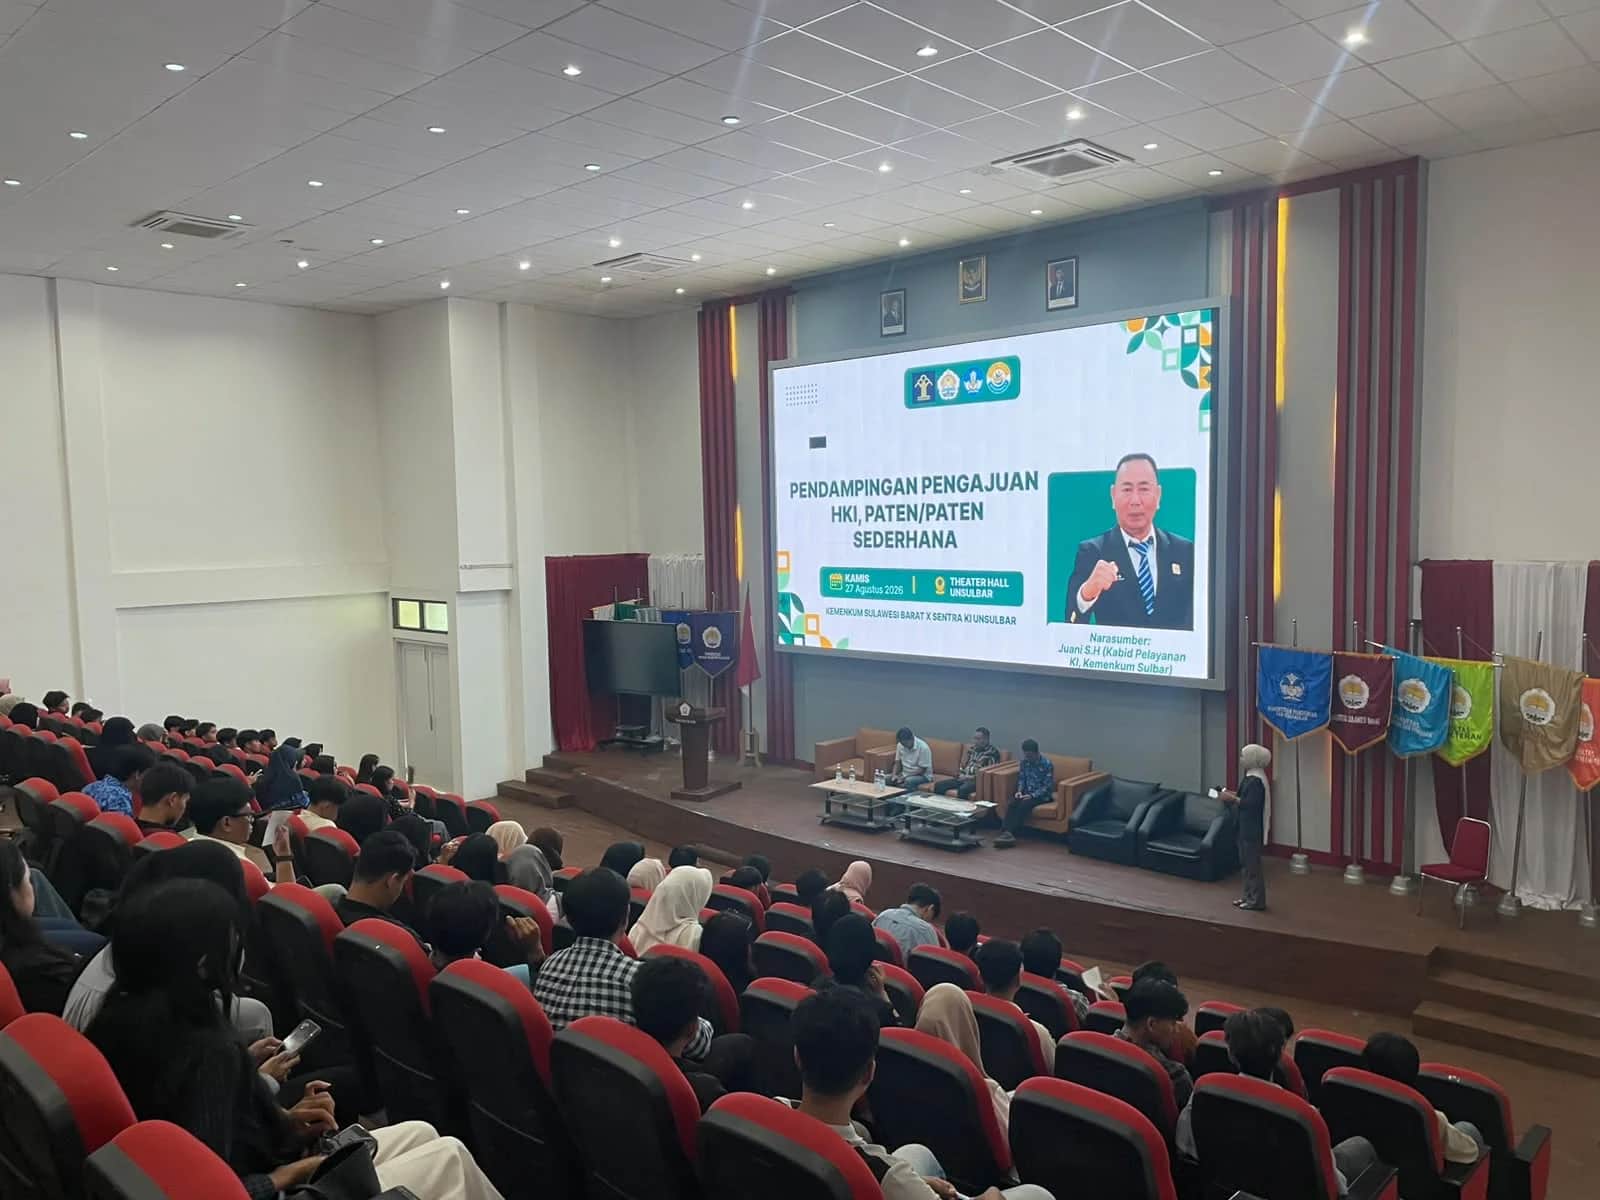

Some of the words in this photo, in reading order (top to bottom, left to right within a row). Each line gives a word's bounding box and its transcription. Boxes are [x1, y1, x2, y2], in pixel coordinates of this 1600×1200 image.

[790, 477, 918, 499] PENDAMPINGAN
[922, 471, 1039, 494] PENGAJUAN
[831, 505, 862, 526] HKI,
[865, 502, 984, 523] PATEN/PATEN
[853, 530, 958, 549] SEDERHANA
[845, 573, 870, 583] KAMIS
[950, 577, 988, 587] THEATER
[988, 578, 1010, 588] HALL
[845, 584, 854, 593] 27
[855, 585, 883, 595] Agustus
[950, 588, 993, 598] UNSULBAR
[825, 608, 863, 617] KEMENKUM
[864, 609, 899, 619] SULAWESI
[900, 611, 924, 620] BARAT
[932, 612, 963, 622] SENTRA
[964, 614, 972, 623] KI
[973, 615, 1017, 625] UNSULBAR
[1089, 633, 1152, 646] Narasumber:
[1058, 644, 1083, 655] Juani
[1084, 645, 1101, 656] S.H
[1102, 646, 1133, 659] (Kabid
[1135, 650, 1186, 663] Pelayanan
[1069, 657, 1081, 668] KI,
[1083, 659, 1135, 672] Kemenkum
[1137, 662, 1173, 676] Sulbar)
